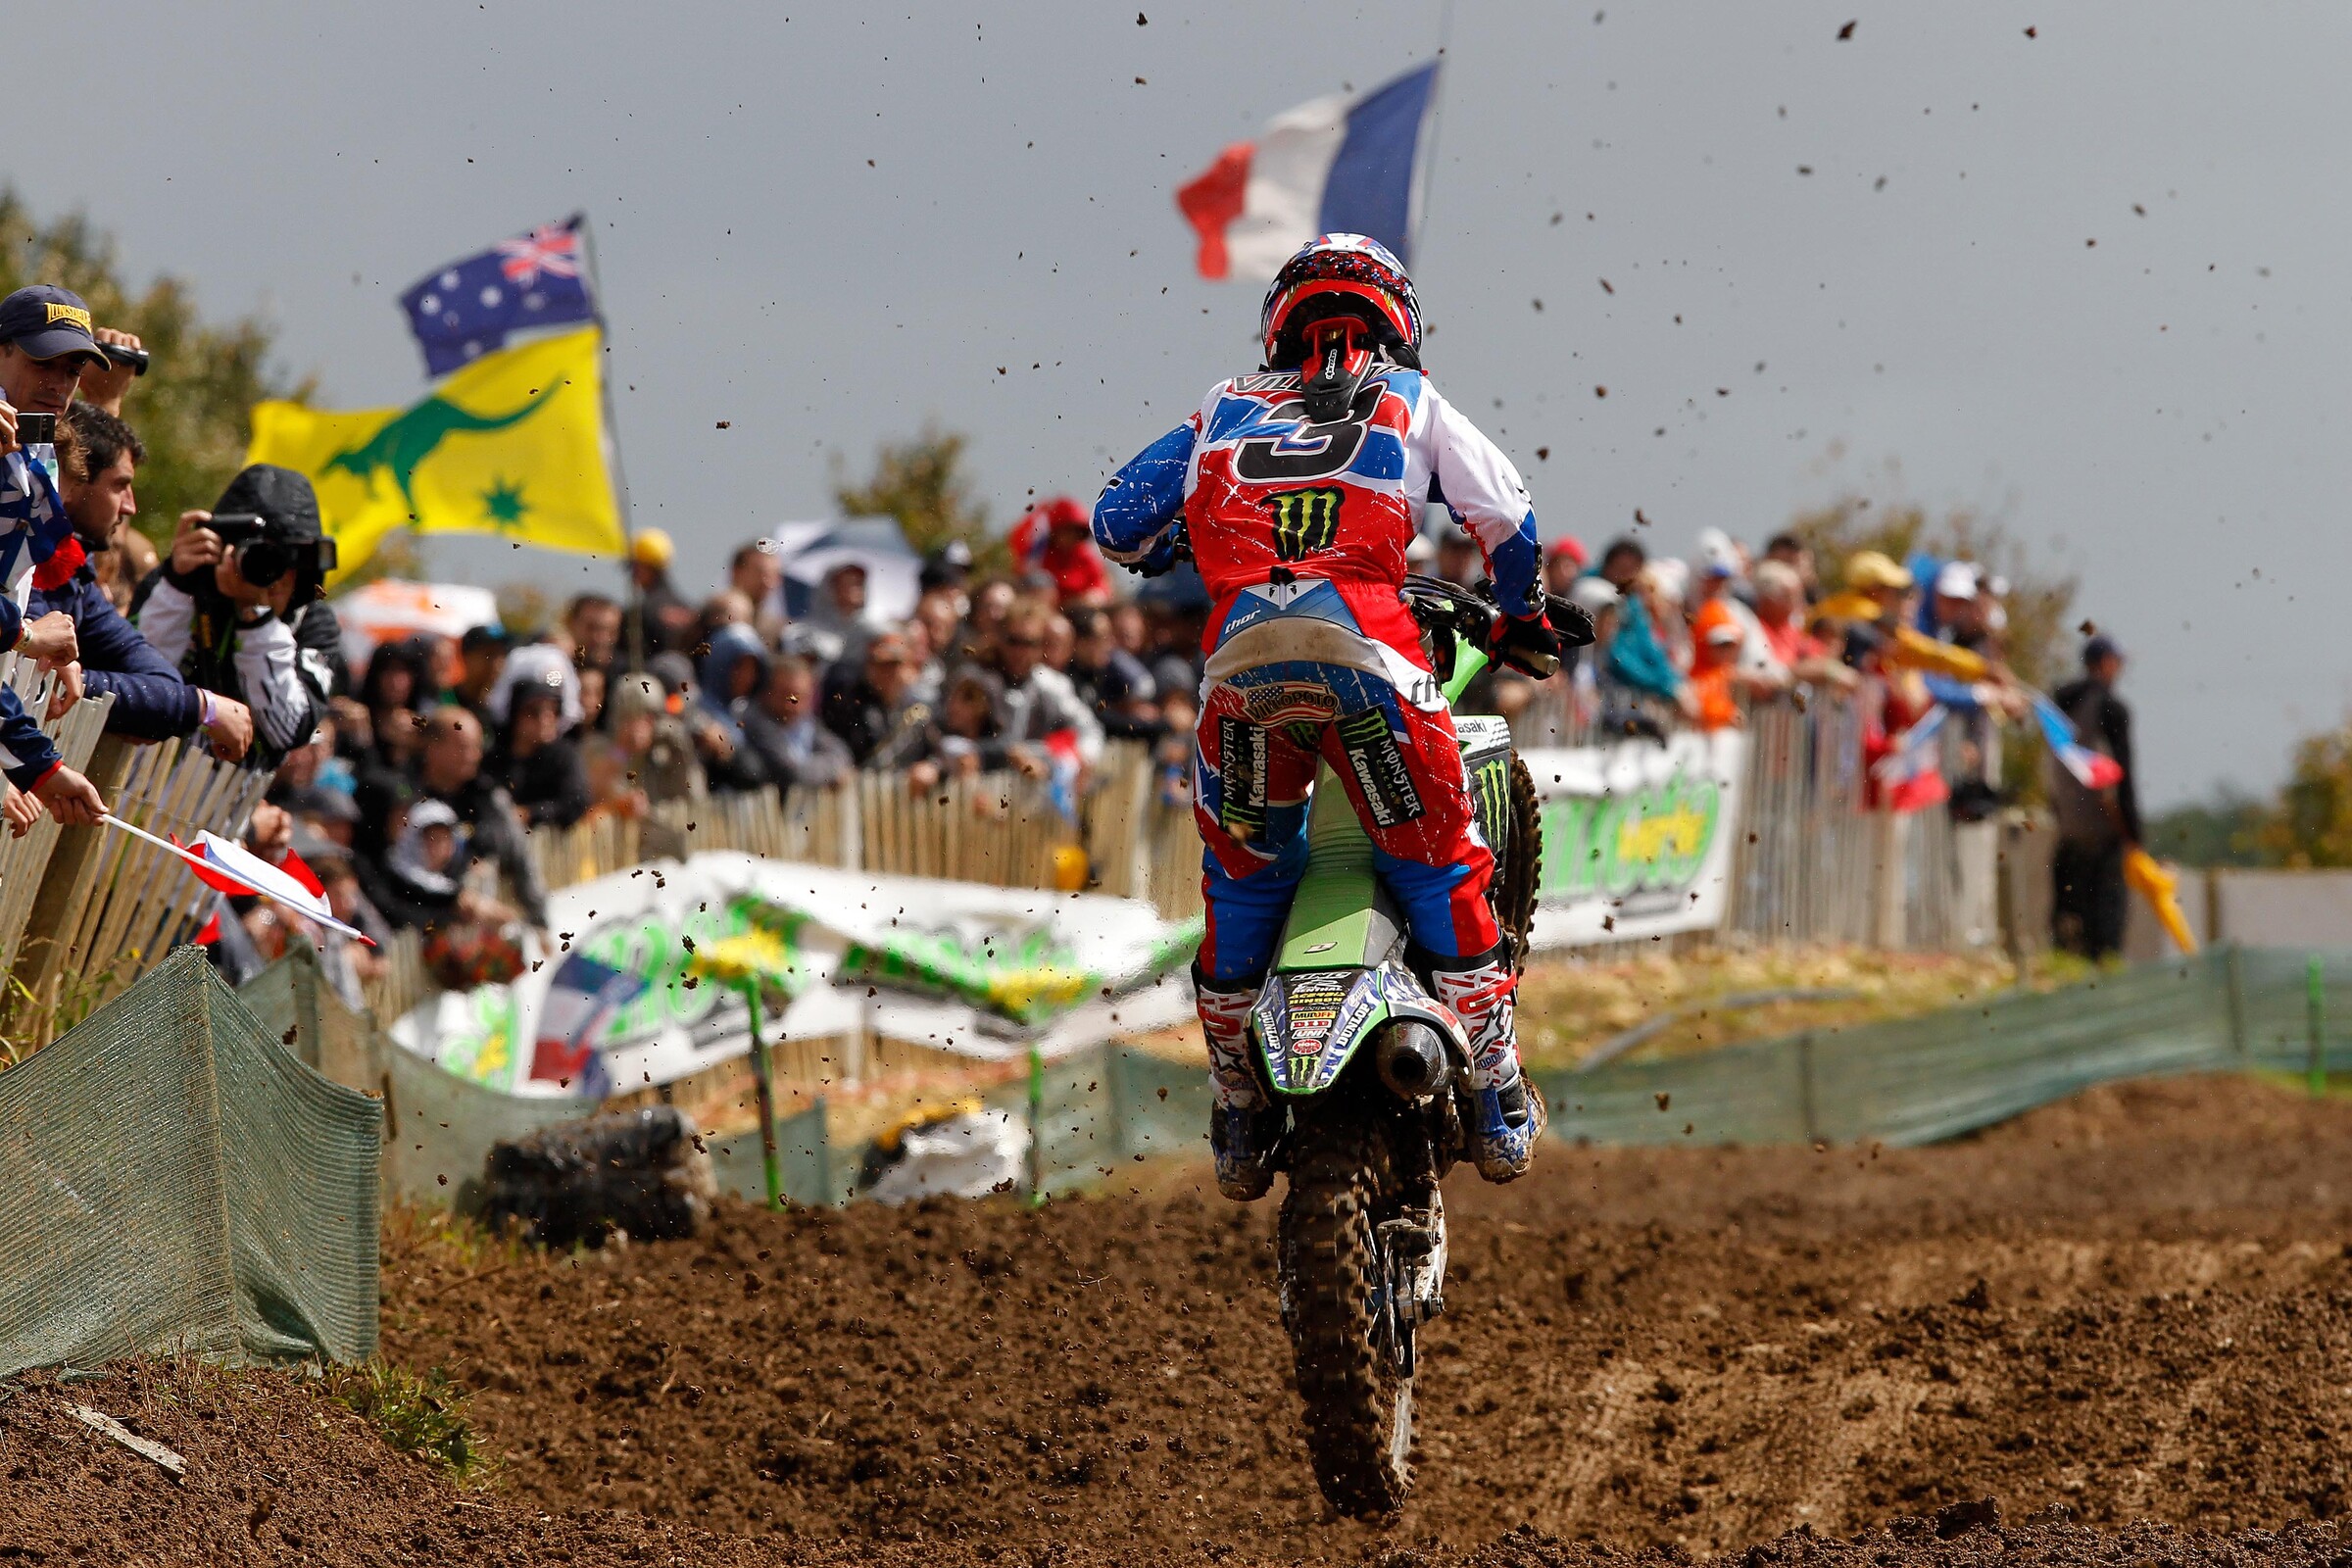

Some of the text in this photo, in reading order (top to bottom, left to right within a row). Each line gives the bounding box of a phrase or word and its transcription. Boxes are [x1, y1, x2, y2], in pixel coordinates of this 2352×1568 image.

[1232, 380, 1389, 483] 3
[1225, 610, 1261, 636] thor
[1246, 690, 1339, 722] VILLOPOTO
[1455, 718, 1488, 734] asaki
[1222, 720, 1236, 801] MONSTER
[1249, 726, 1266, 808] Kawasaki
[1380, 737, 1421, 817] MONSTER
[1348, 748, 1396, 826] Kawasaki
[1288, 997, 1344, 1005] HINSON
[1260, 1009, 1282, 1050] DUNLOP
[1336, 1003, 1371, 1048] DUNLOP
